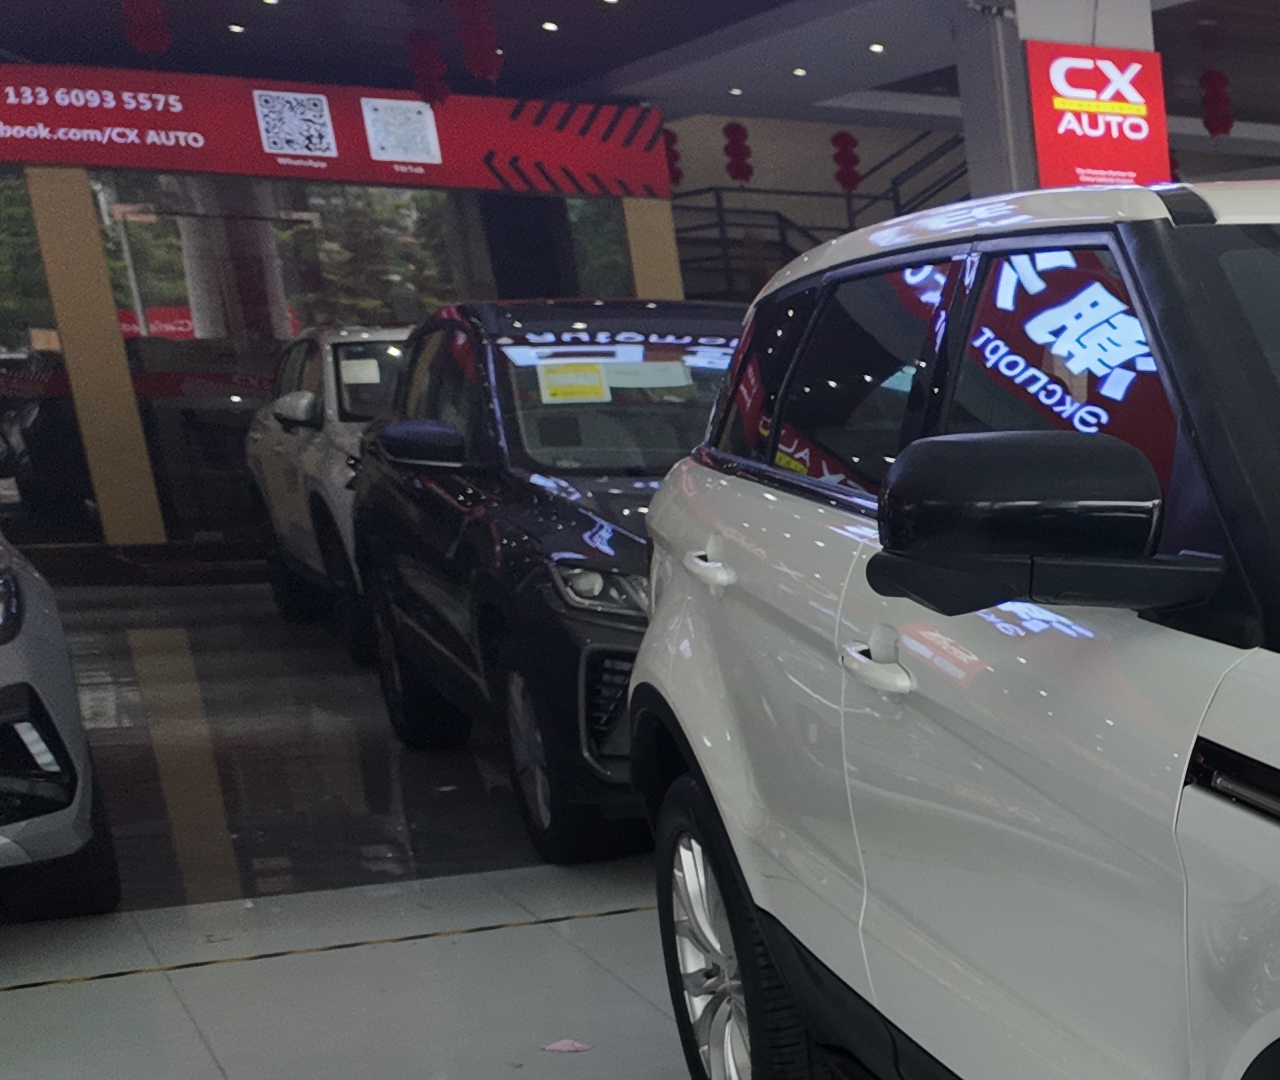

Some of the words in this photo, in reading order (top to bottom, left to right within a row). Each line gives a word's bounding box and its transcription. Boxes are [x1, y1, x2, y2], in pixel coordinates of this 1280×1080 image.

[1049, 56, 1146, 104] CX
[4, 86, 50, 106] 133
[54, 88, 117, 109] 6093
[121, 91, 183, 112] 5575
[145, 130, 205, 148] AUTO
[1057, 111, 1150, 141] AUTO
